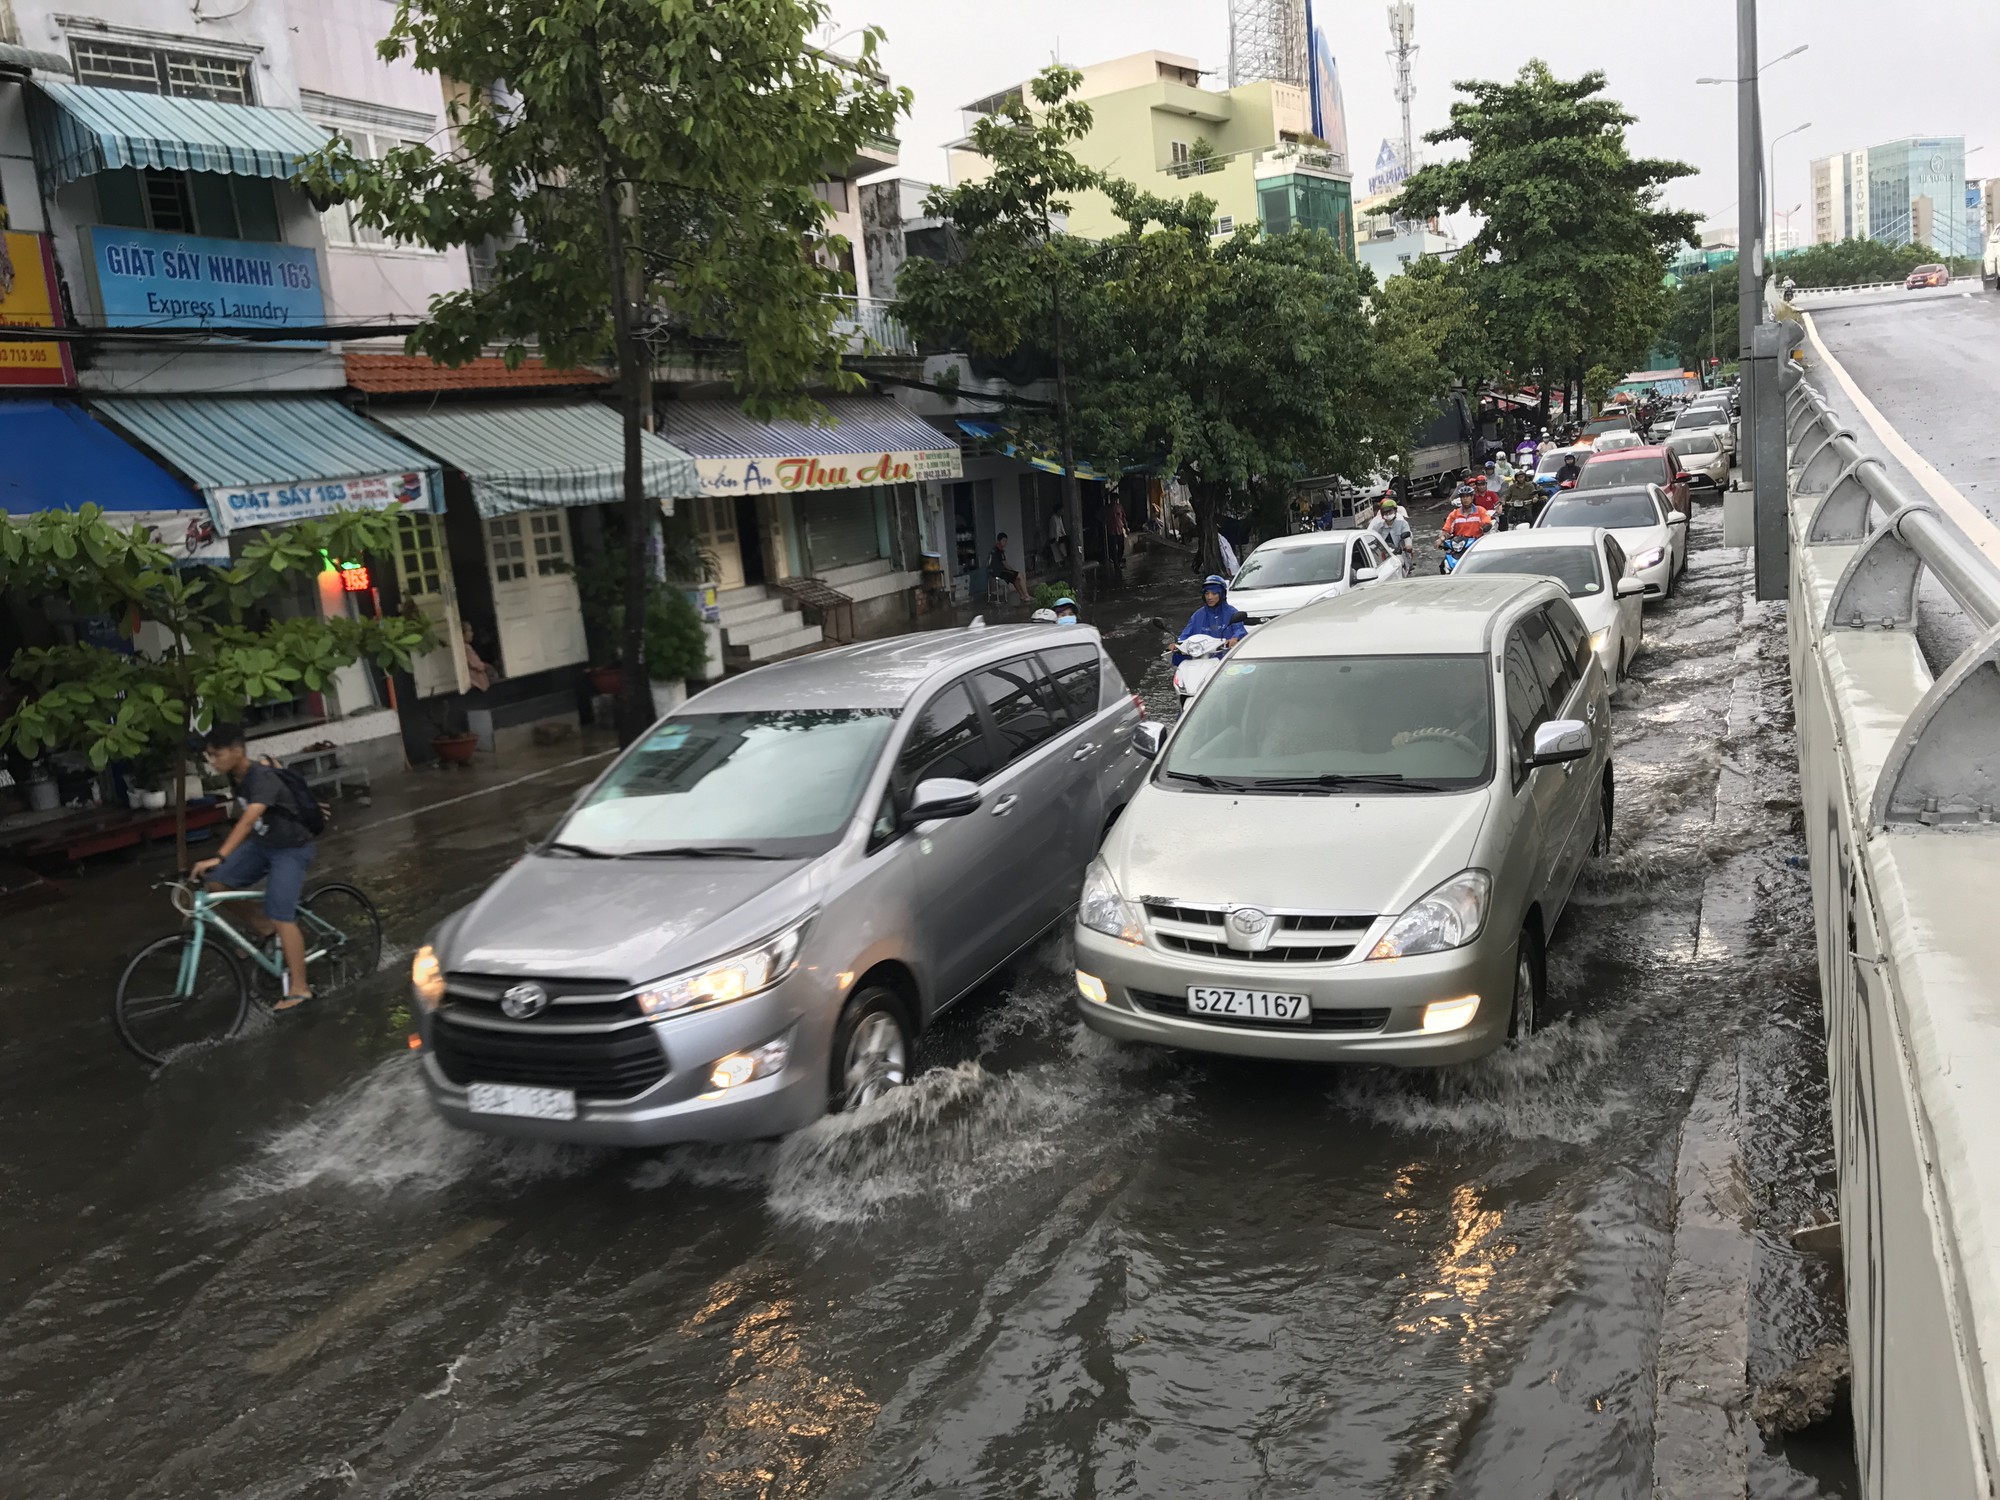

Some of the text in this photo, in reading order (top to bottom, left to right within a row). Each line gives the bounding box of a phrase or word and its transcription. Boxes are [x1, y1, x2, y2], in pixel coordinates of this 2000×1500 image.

[105, 241, 312, 290] GIẶT SẤY NHANH 163
[147, 292, 290, 324] Express Laundry
[775, 457, 851, 490] Thu
[856, 453, 914, 481] An
[316, 484, 347, 502] 163
